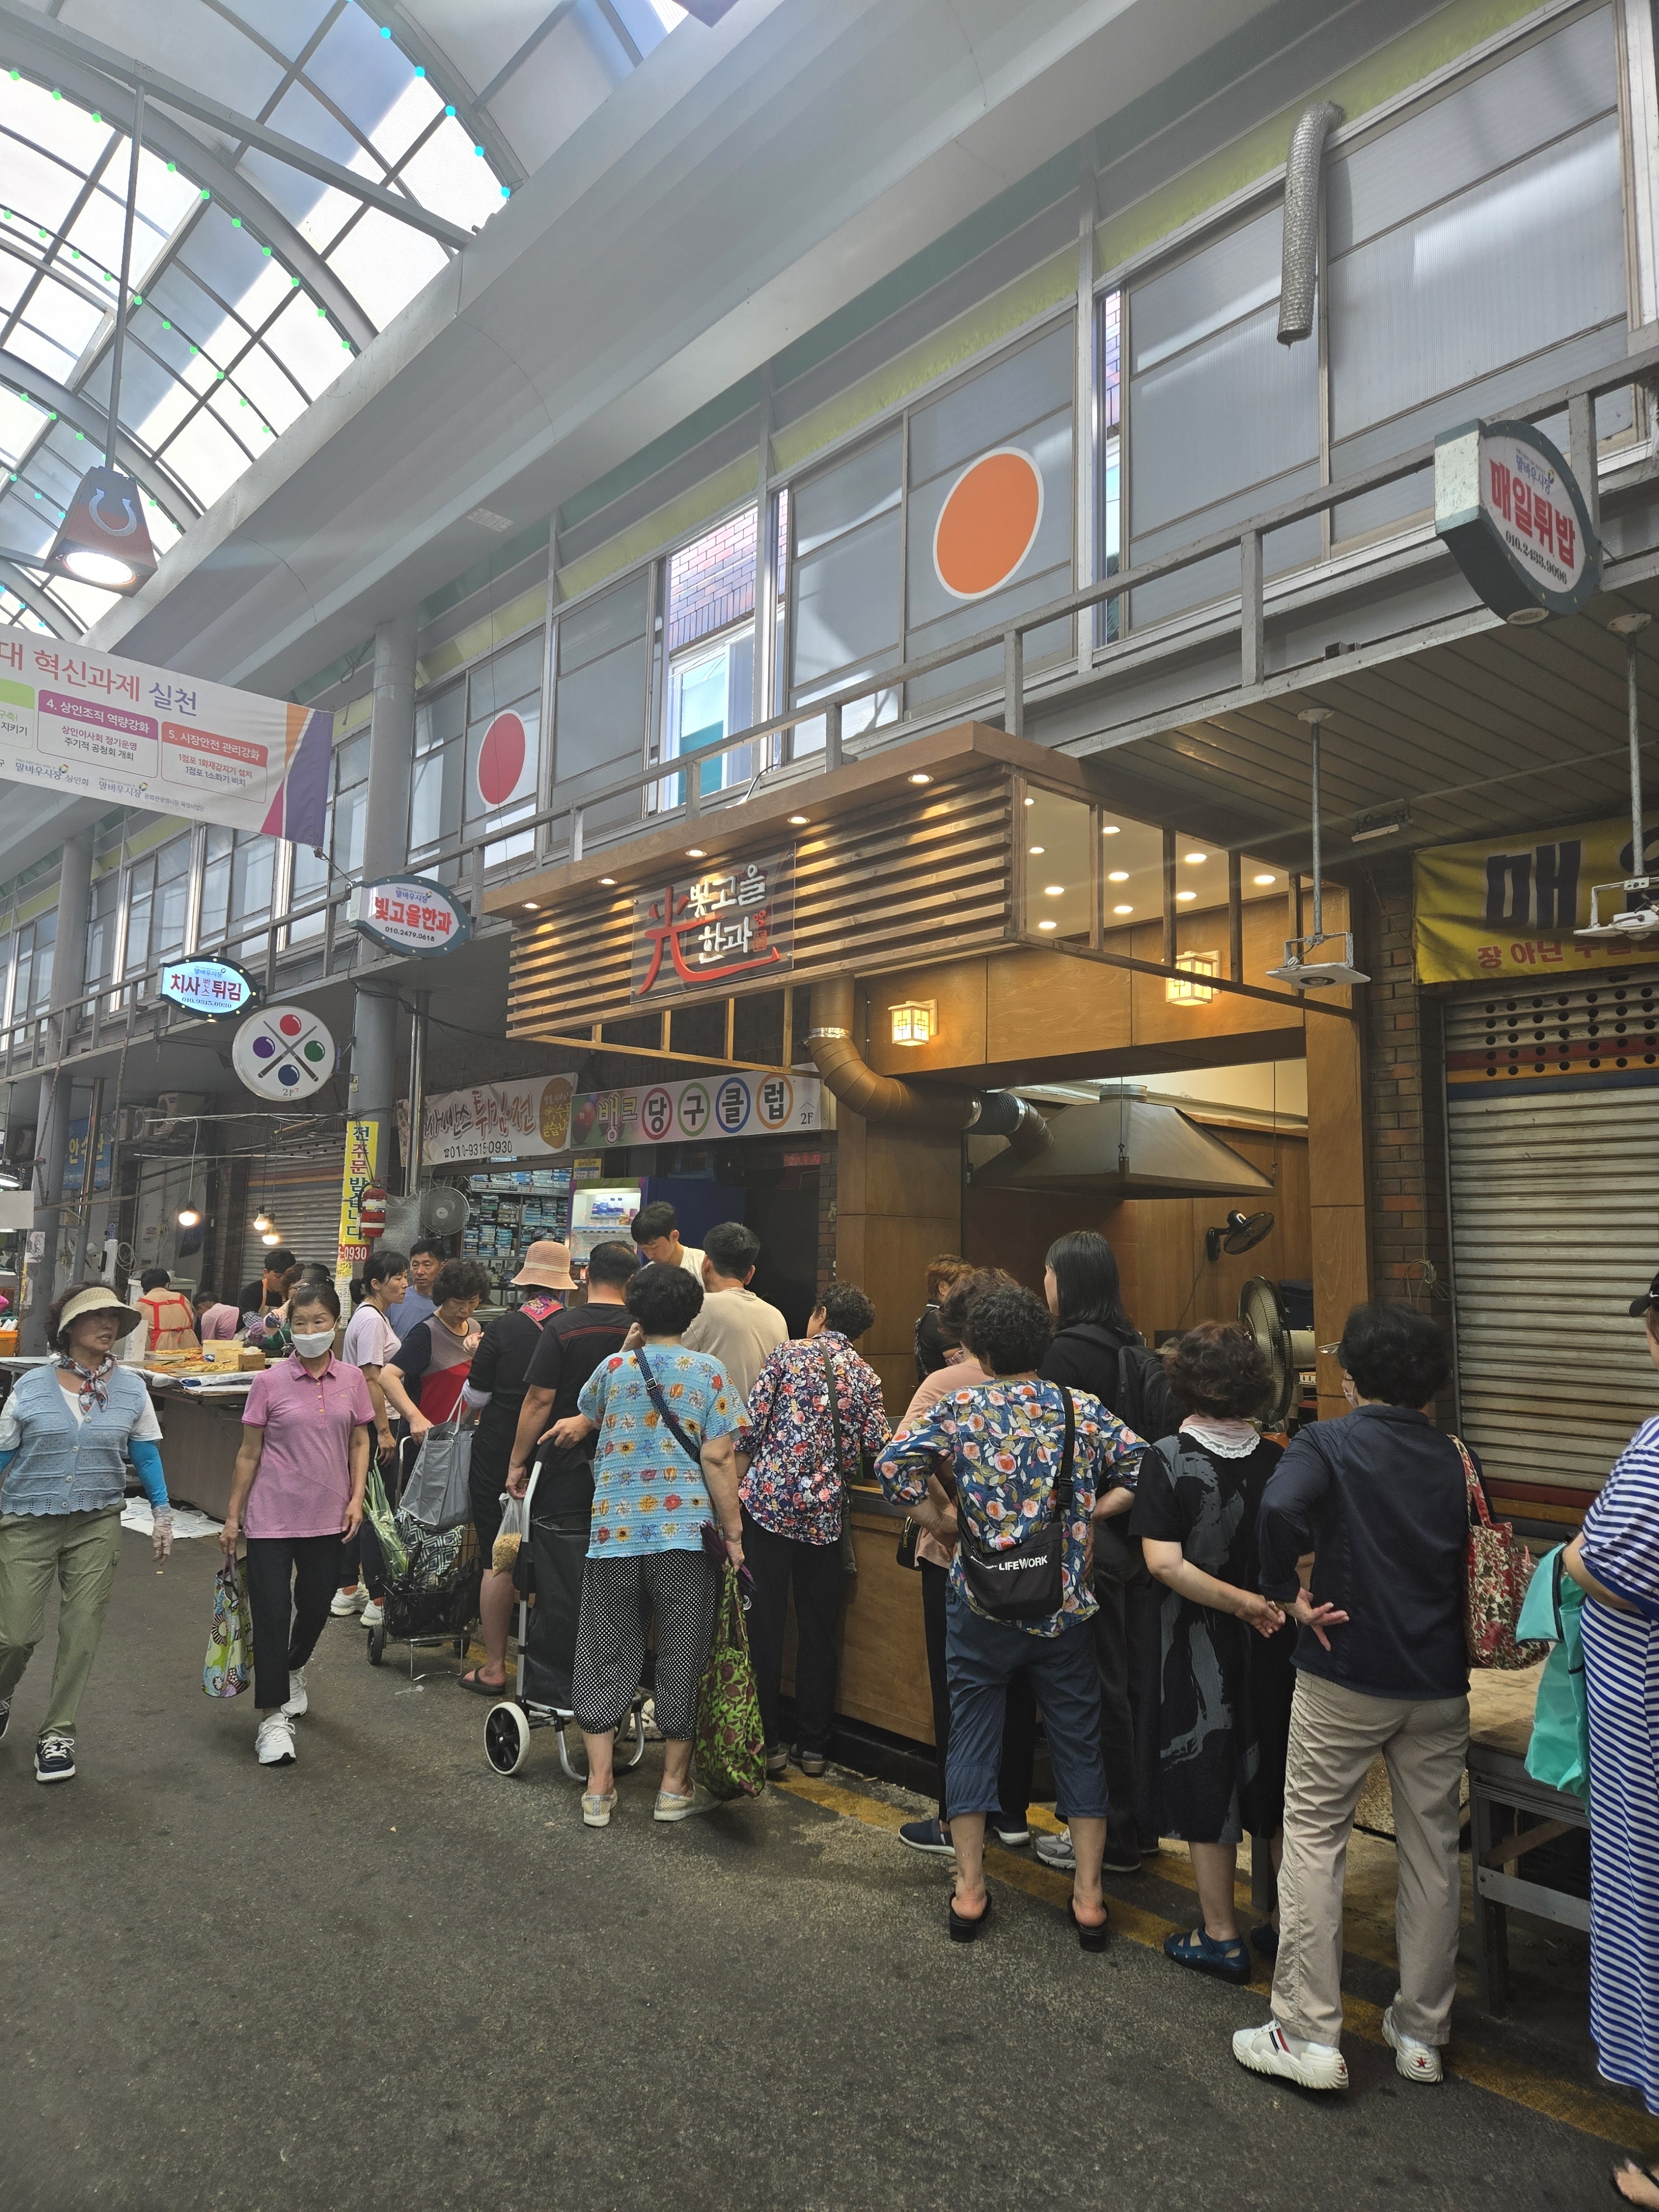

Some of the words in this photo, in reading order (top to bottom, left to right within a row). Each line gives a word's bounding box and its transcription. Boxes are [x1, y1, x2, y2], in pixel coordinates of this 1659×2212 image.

[1489, 459, 1575, 569] 매일튀밥
[33, 649, 140, 702] 혁신과제
[148, 681, 197, 717] 실천
[1, 722, 27, 736] 지키기
[60, 701, 104, 722] 상인조직
[107, 713, 149, 733] 역량강화
[61, 725, 103, 743] 상인이사회
[105, 735, 137, 750] 정기운영
[64, 737, 89, 750] 주기적
[91, 743, 116, 757] 공청회
[118, 750, 134, 761] 개최
[180, 733, 220, 750] 시장안전
[222, 742, 260, 761] 관리강화
[15, 762, 62, 780] 말바우시장
[65, 775, 89, 786] 상인회
[179, 754, 196, 764] 1점포
[199, 758, 236, 774] 1화재감지기
[238, 769, 253, 779] 설치
[205, 771, 230, 784] 1소화기
[232, 778, 246, 787] 비치
[98, 781, 142, 797] 말바우시장
[396, 890, 427, 904] 말바우시장
[687, 864, 766, 919] 빛고을
[375, 897, 452, 935] 빛고을한과
[385, 926, 435, 941] 010.2479.0618
[637, 885, 781, 995] 光
[698, 916, 753, 964] 한과
[1510, 941, 1564, 964] 아닌
[170, 974, 200, 995] 치사
[212, 980, 242, 1001] 튀김
[182, 997, 232, 1008] 010.9315.0930
[595, 1093, 638, 1144] 뱅크
[800, 1112, 813, 1125] 2F
[999, 1555, 1048, 1571] LIFEWORK
